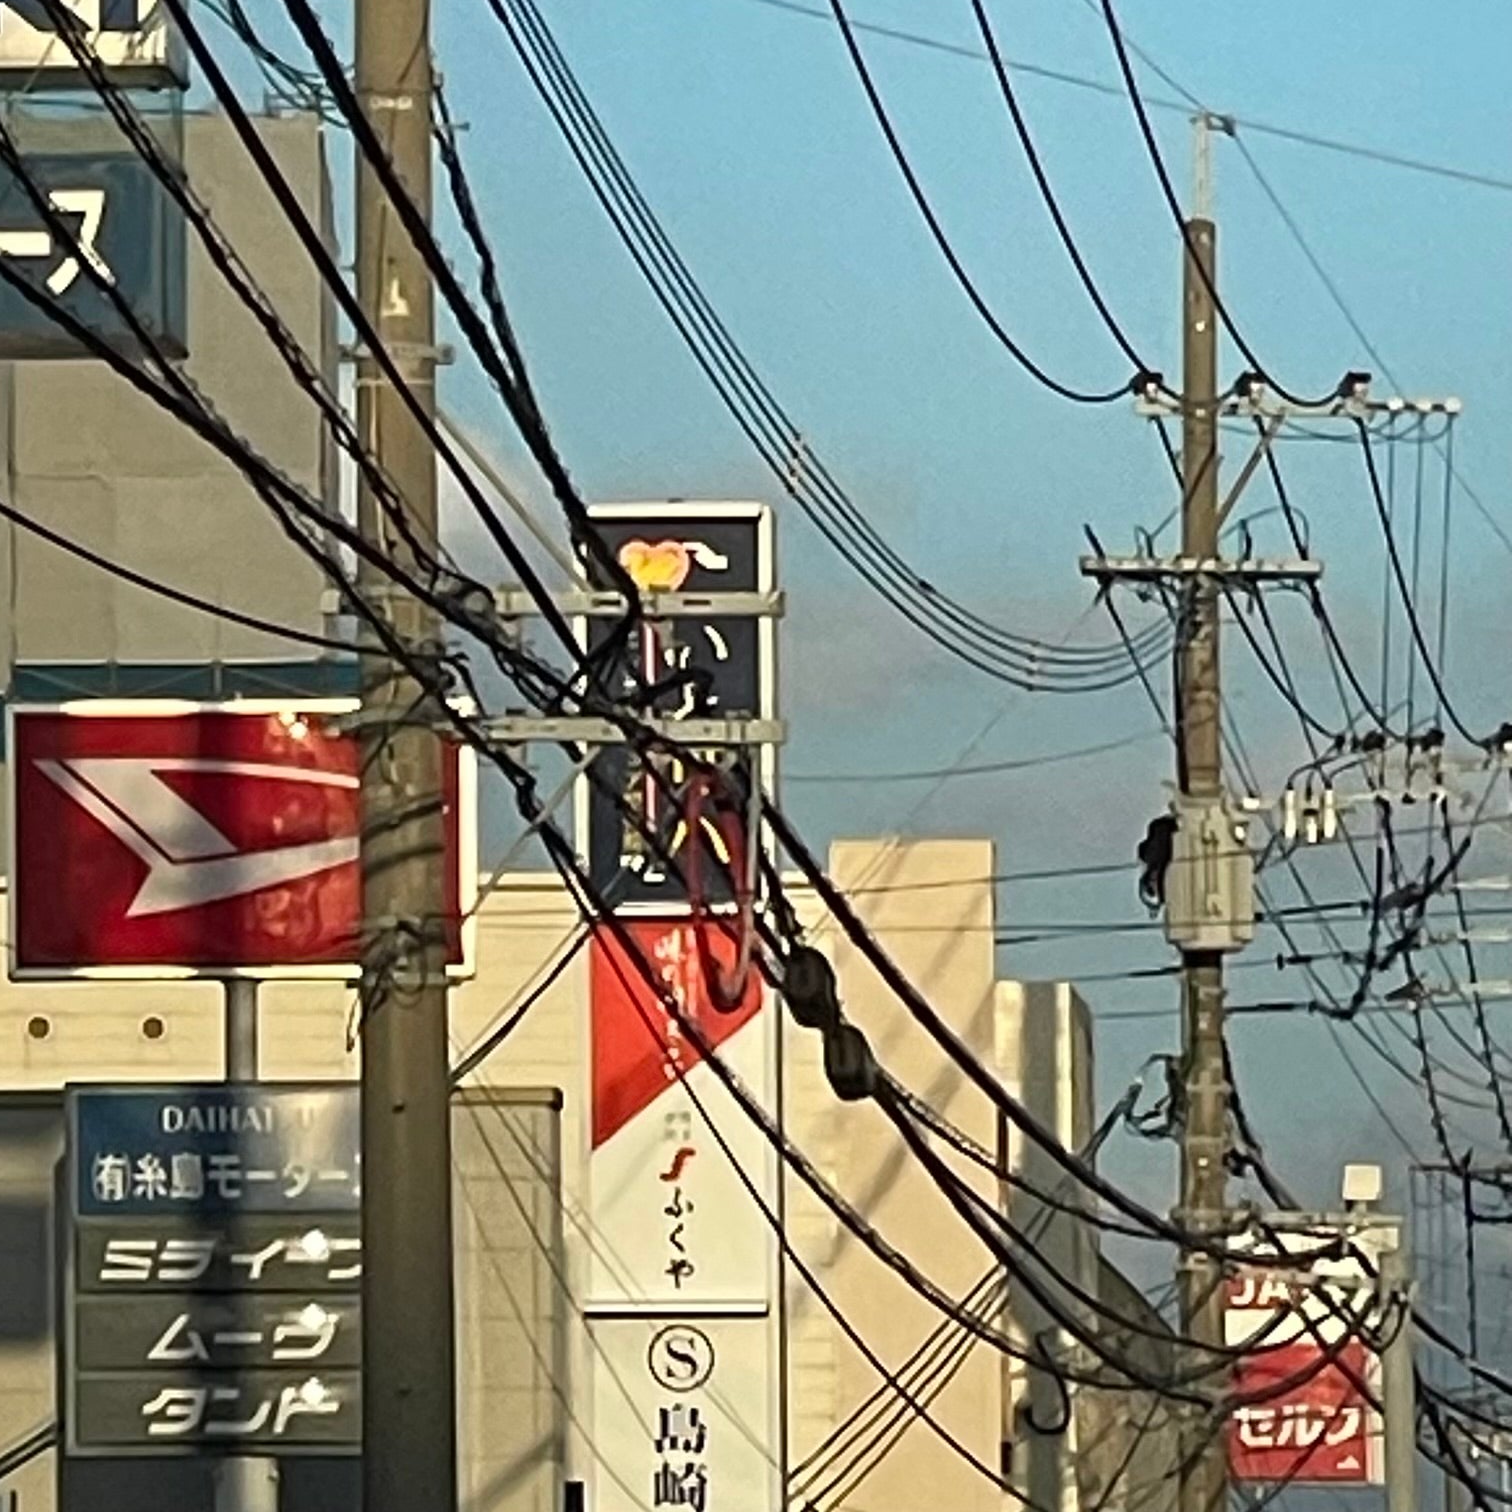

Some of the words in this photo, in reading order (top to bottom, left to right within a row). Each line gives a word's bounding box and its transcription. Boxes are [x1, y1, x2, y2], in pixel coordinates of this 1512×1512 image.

[161, 1105, 315, 1133] DAIHATU
[662, 1187, 695, 1289] ふくや
[1232, 1405, 1361, 1447] セルフ
